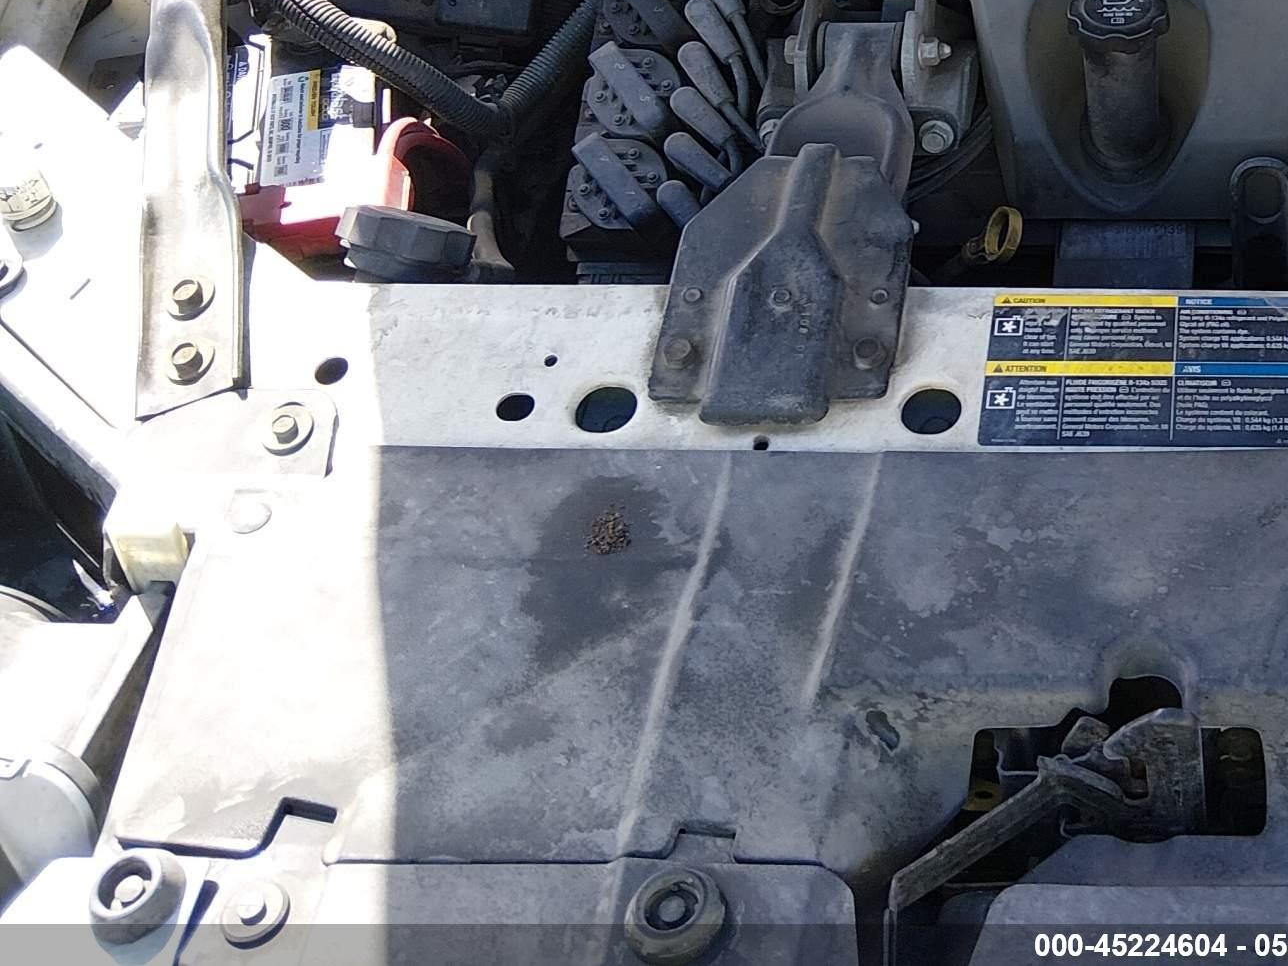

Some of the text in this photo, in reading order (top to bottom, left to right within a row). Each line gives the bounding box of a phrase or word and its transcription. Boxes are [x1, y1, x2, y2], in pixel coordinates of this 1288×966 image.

[1012, 297, 1046, 305] CAUTION
[1005, 365, 1048, 373] ATTENTION
[1182, 365, 1201, 373] AVIS
